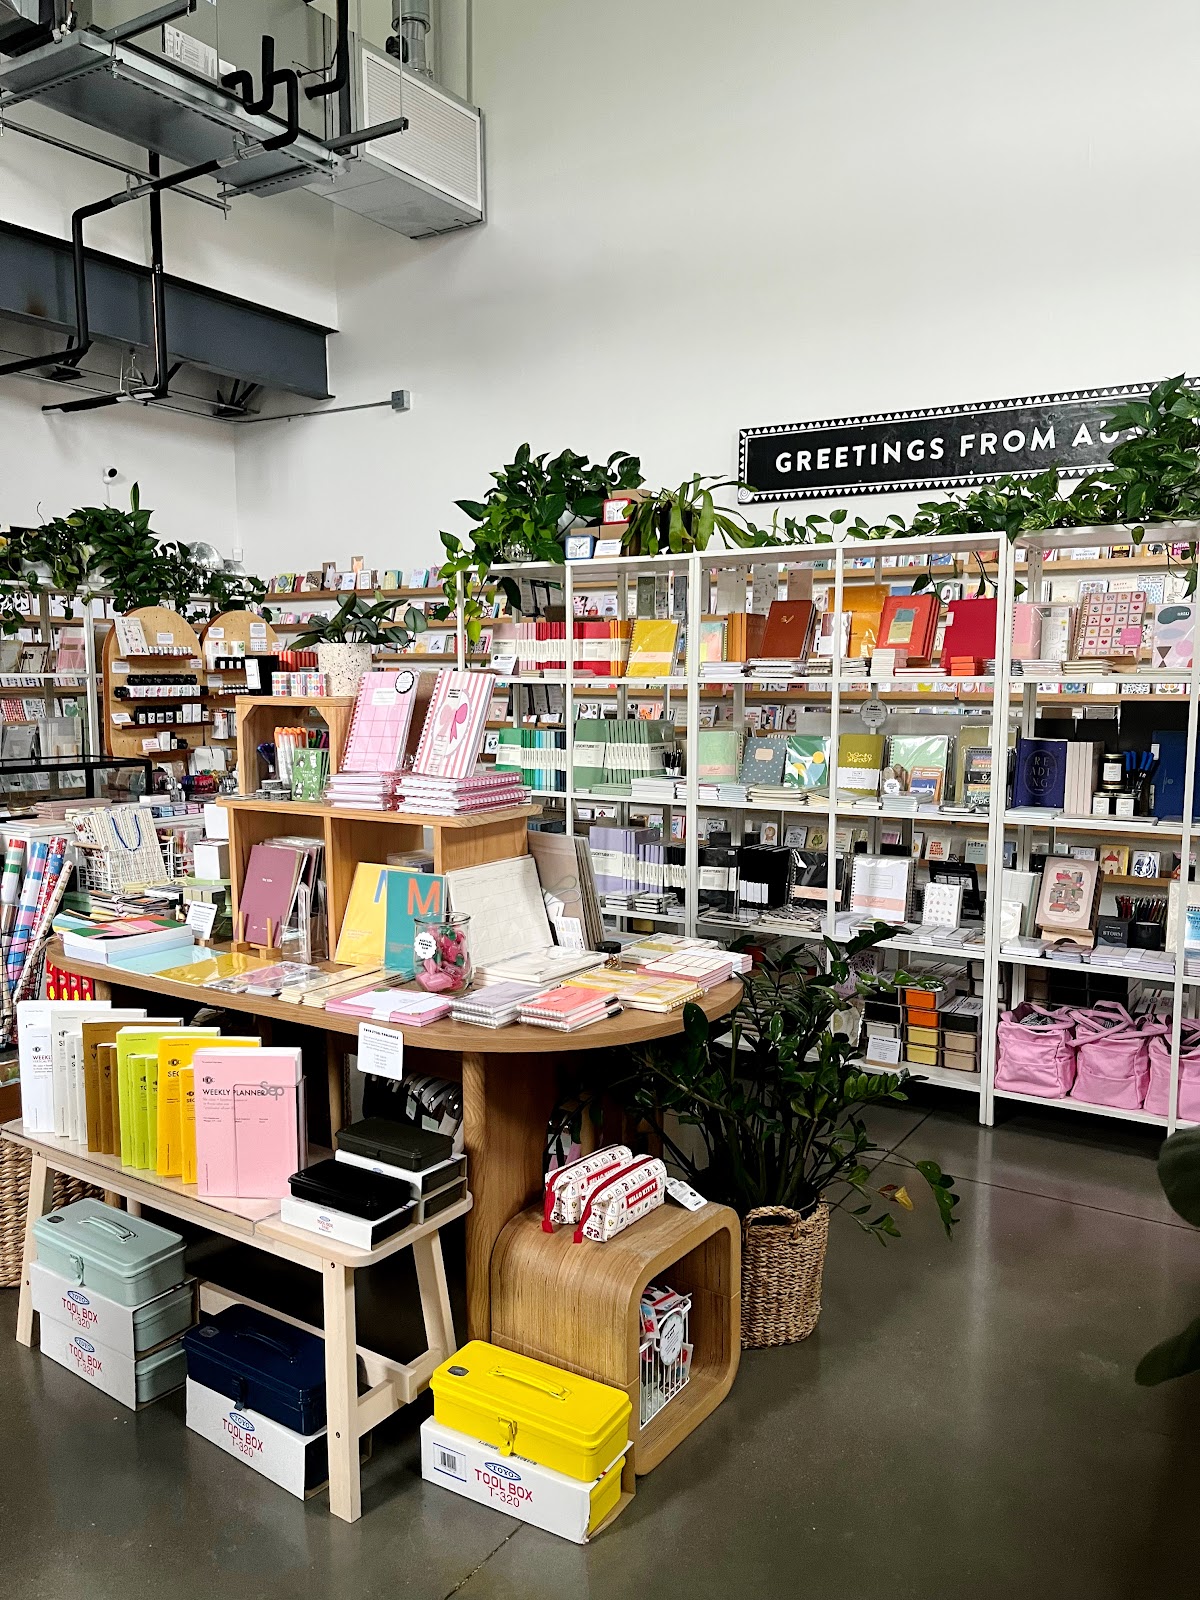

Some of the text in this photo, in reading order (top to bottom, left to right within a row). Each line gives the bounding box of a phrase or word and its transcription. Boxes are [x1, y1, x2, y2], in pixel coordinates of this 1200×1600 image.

[775, 437, 945, 473] GREETINGS
[960, 426, 1056, 458] FROM
[407, 878, 441, 915] M
[233, 1089, 265, 1097] PLANNER
[260, 1081, 284, 1101] Sep
[62, 1297, 98, 1324] TOOL BOX
[70, 1313, 91, 1329] T-320
[69, 1343, 103, 1372] TOOL BOX
[76, 1359, 95, 1377] T-320
[233, 1414, 250, 1429] TOYO
[222, 1418, 264, 1453] TOOL BOX
[231, 1436, 254, 1458] T-320
[492, 1466, 514, 1478] TOYO
[474, 1468, 533, 1502] TOOL BOX
[487, 1486, 520, 1508] T-320
